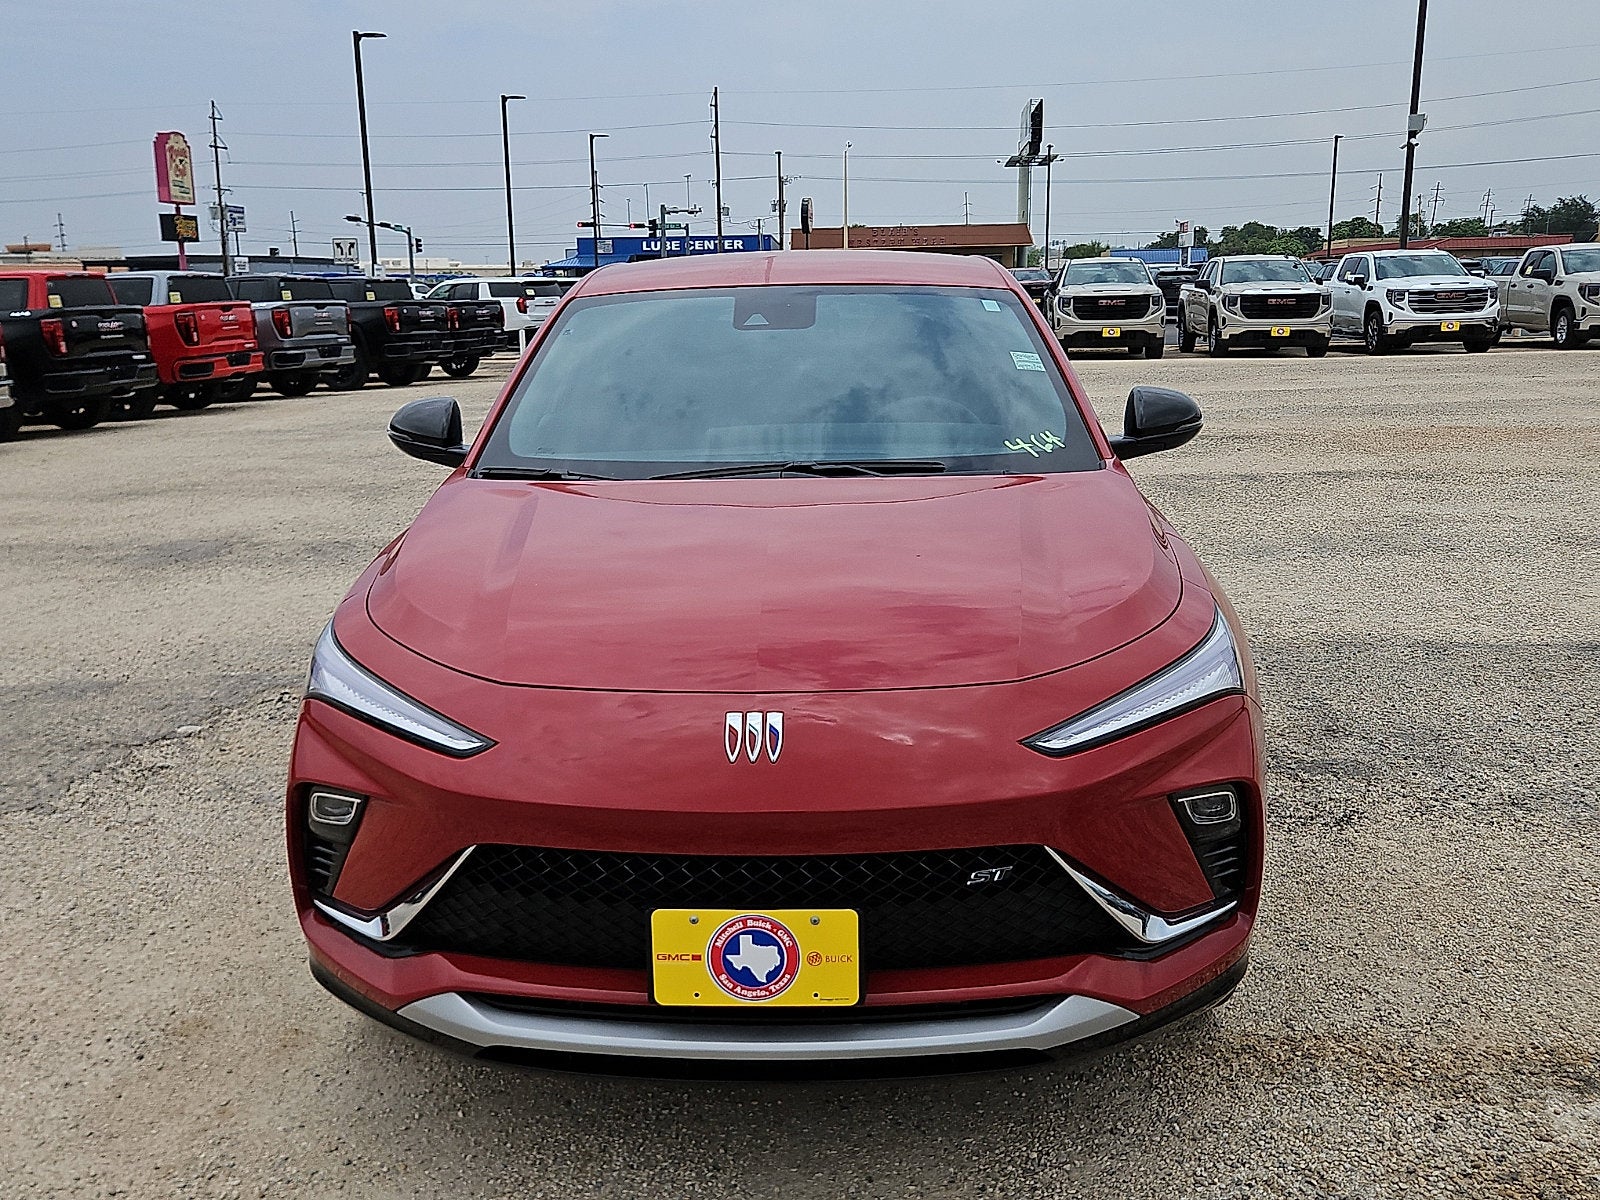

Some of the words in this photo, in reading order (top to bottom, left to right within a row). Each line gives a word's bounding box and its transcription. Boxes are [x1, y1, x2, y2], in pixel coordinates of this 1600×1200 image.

[642, 240, 681, 251] LUBE
[1004, 430, 1066, 458] 464
[966, 865, 1013, 886] ST
[715, 921, 744, 949] Mitchell
[746, 919, 772, 930] Buick
[776, 929, 793, 948] GMC
[656, 953, 691, 962] GMC
[825, 954, 853, 963] BUICK
[718, 973, 735, 990] San
[768, 973, 791, 993] Texas
